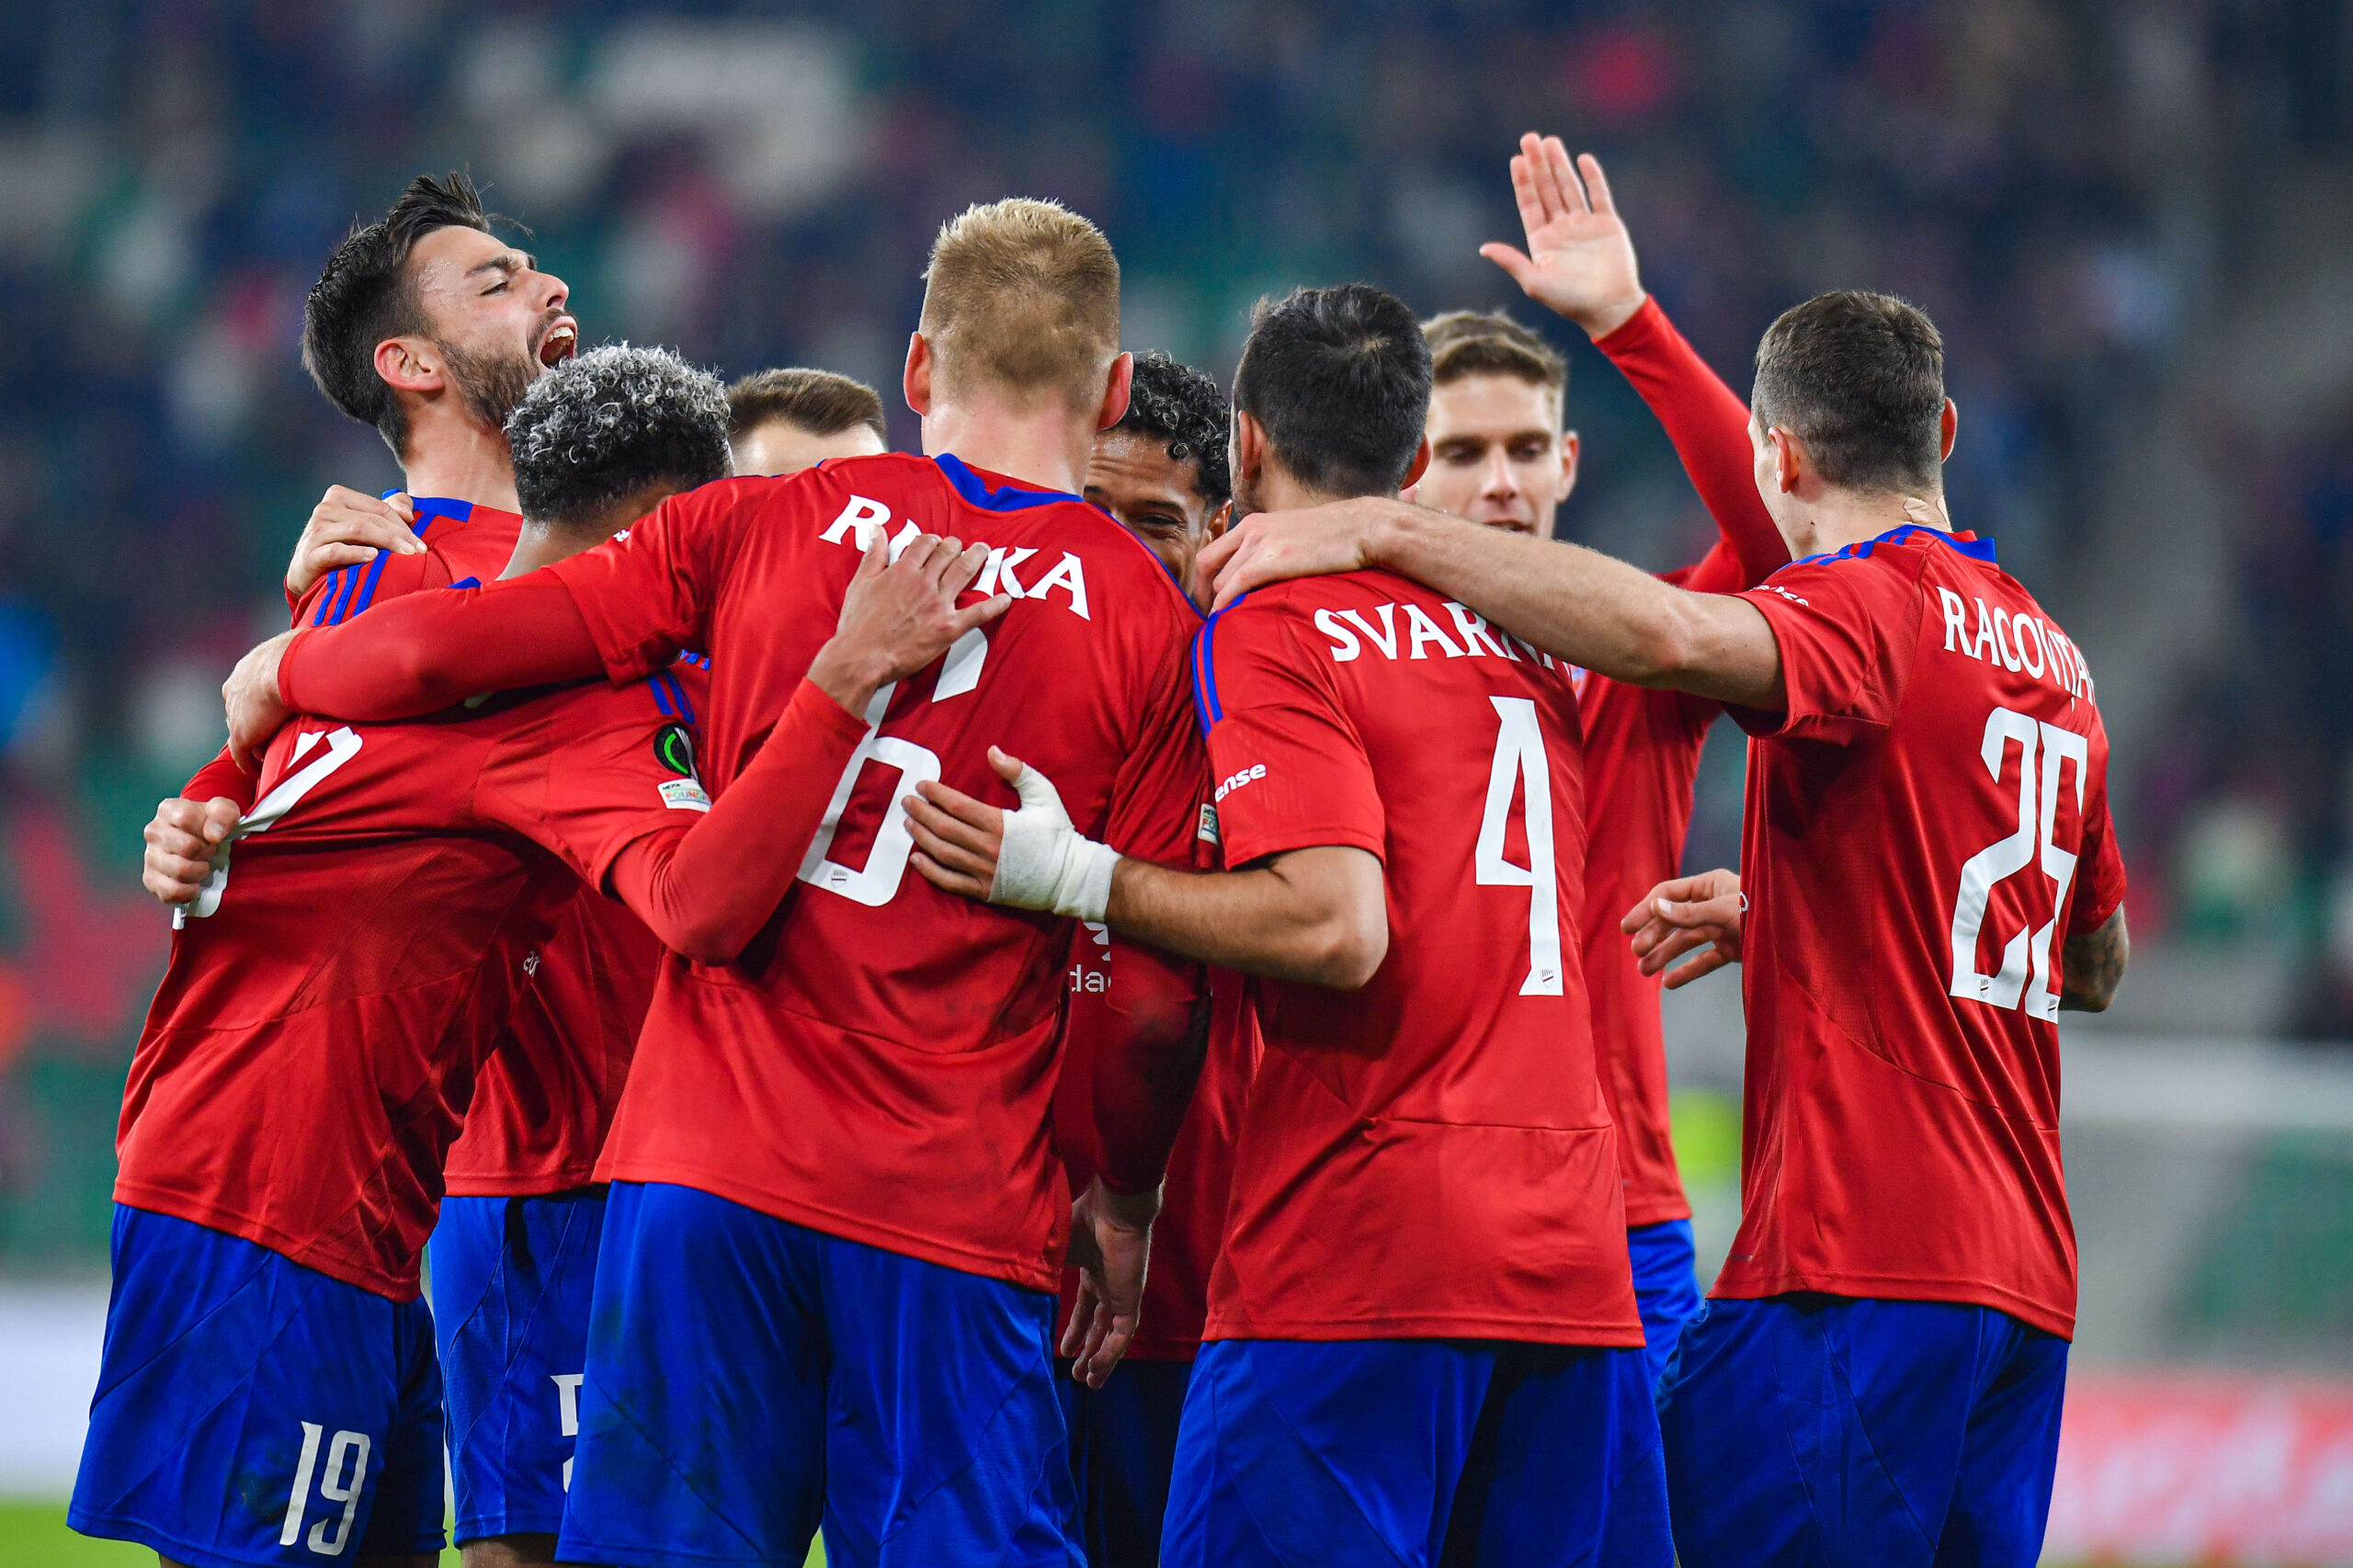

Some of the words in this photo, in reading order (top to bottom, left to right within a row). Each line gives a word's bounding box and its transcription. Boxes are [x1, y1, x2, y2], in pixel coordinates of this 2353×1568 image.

[796, 627, 988, 906] 6
[1476, 696, 1563, 996] 4
[1949, 707, 2087, 1024] 25
[279, 1422, 370, 1556] 19
